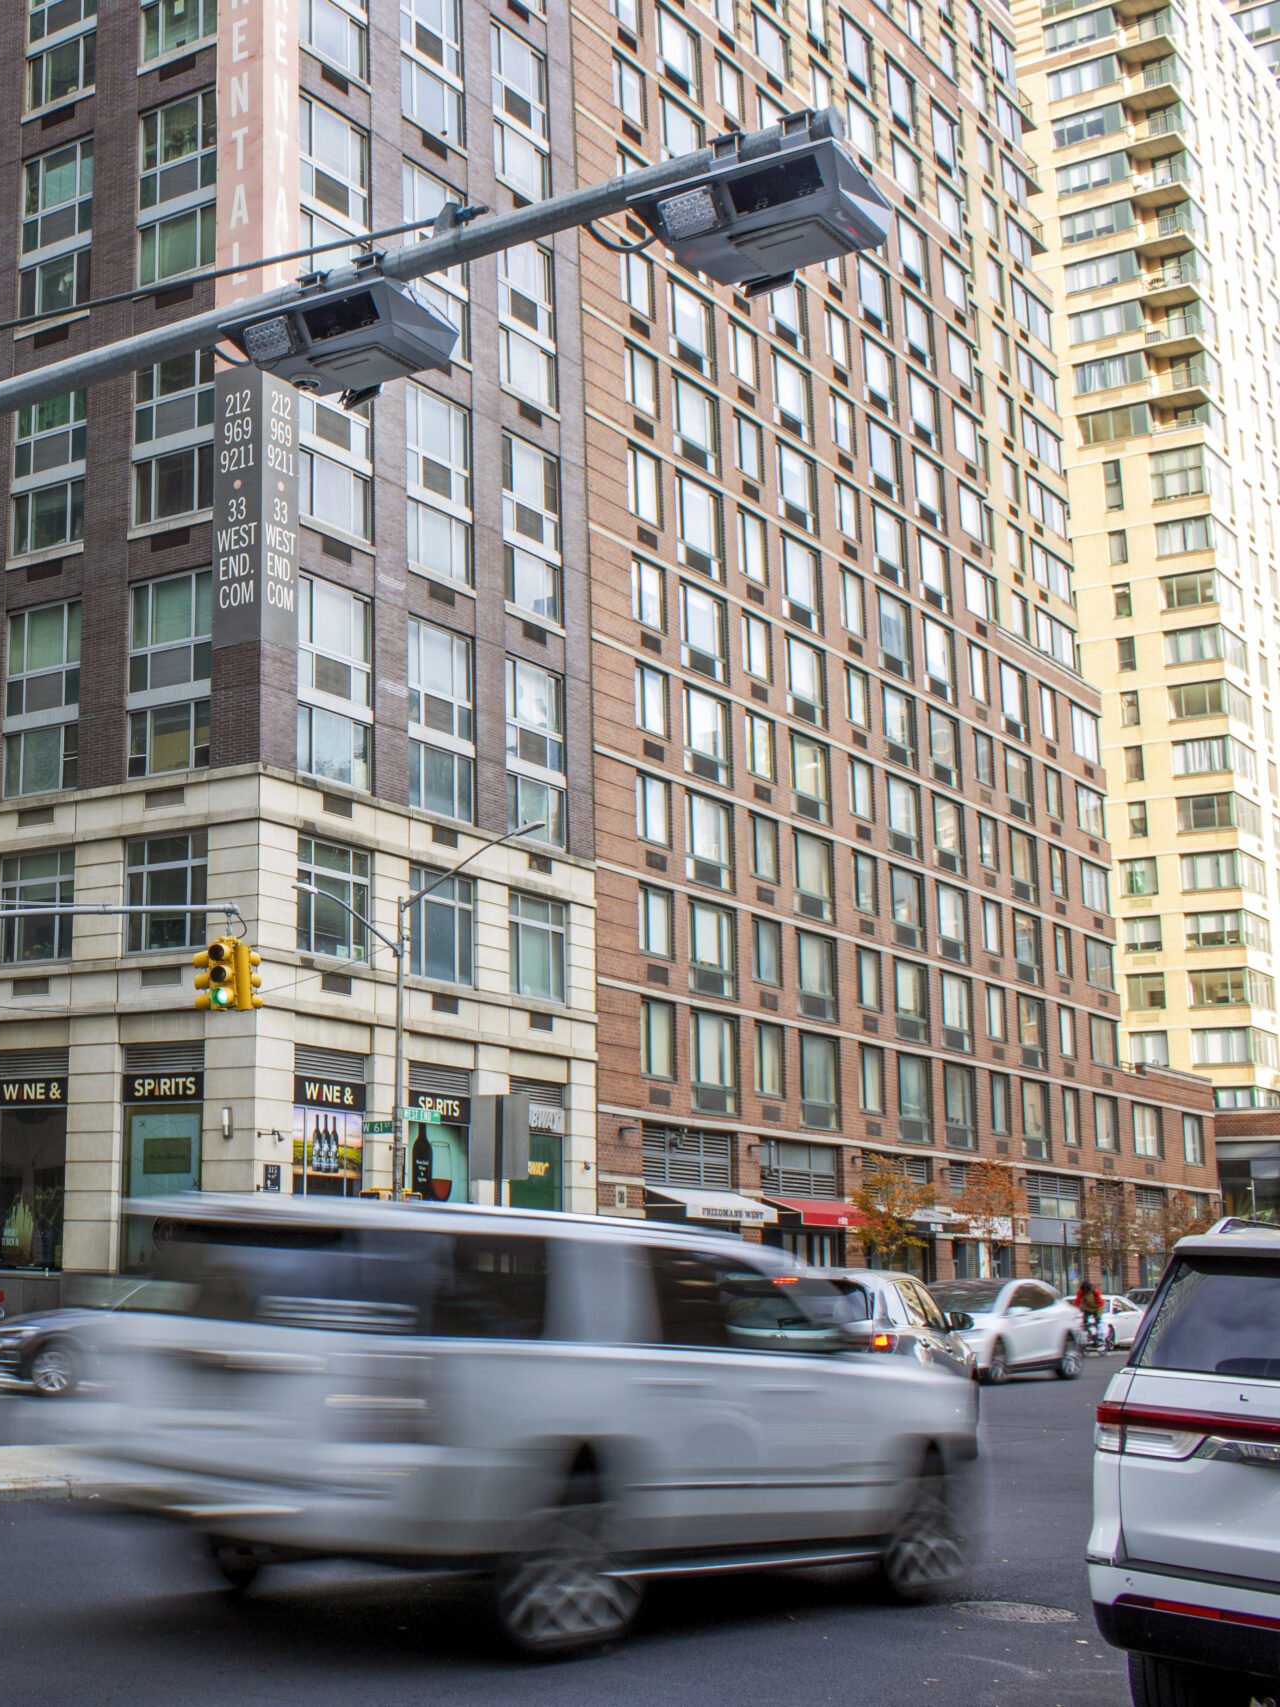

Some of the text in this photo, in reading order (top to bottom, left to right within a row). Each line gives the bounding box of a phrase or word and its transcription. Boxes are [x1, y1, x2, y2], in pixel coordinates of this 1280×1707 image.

[230, 0, 249, 303] ENTAL
[274, 0, 289, 287] ENTAL
[225, 389, 252, 418] 212
[271, 391, 292, 420] 212
[224, 416, 252, 445] 969
[270, 417, 292, 447] 969
[220, 443, 255, 473] 9211
[267, 444, 294, 477] 9211
[227, 496, 247, 522] 33
[273, 498, 288, 524] 33
[217, 521, 258, 553] WEST
[265, 522, 297, 555] WEST
[220, 553, 254, 581] END.
[267, 552, 294, 584] END.
[220, 580, 254, 609] COM
[267, 581, 294, 612] COM
[3, 1082, 62, 1100] WINE &
[134, 1077, 196, 1097] SPIRITS
[305, 1081, 354, 1105] WINE &
[362, 1123, 370, 1133] W
[374, 1122, 383, 1133] 61
[403, 1107, 418, 1119] WEST
[420, 1109, 432, 1121] END
[529, 1108, 561, 1129] BWAY
[744, 1209, 765, 1220] WEST
